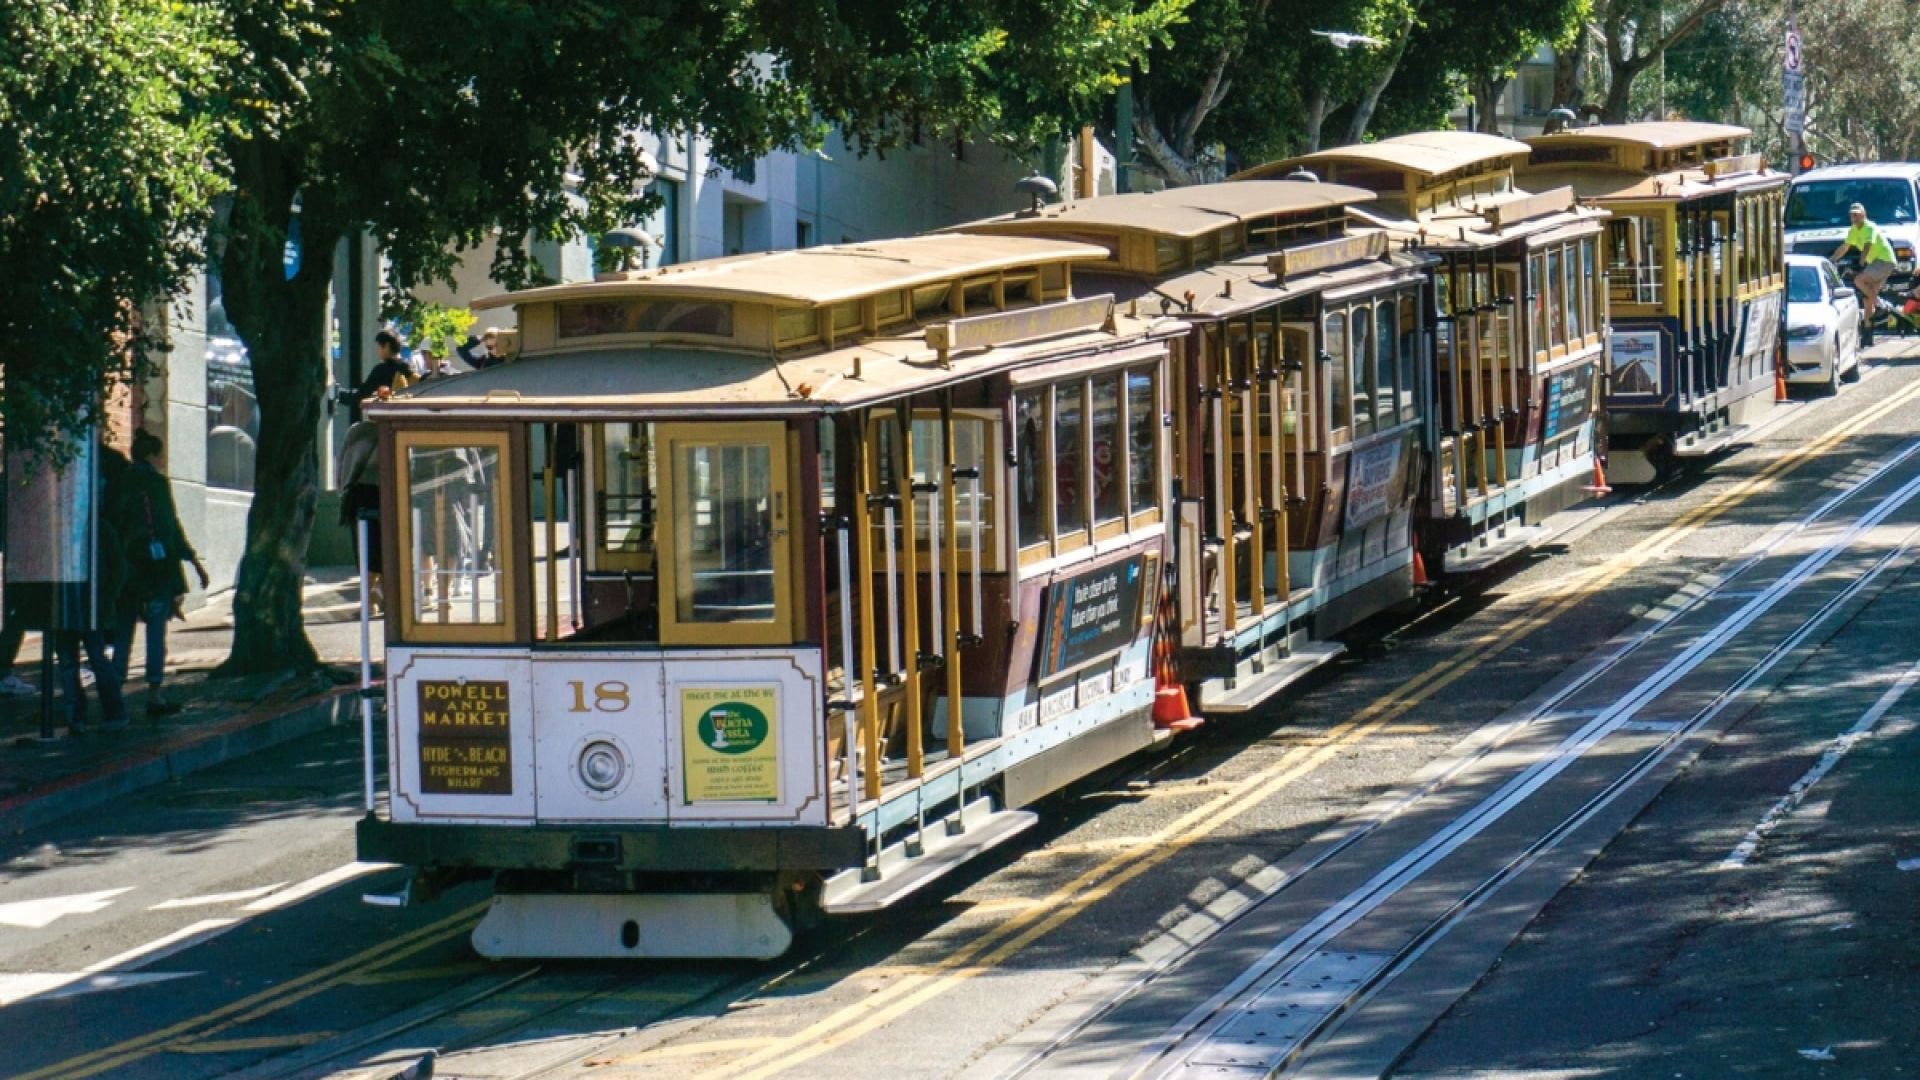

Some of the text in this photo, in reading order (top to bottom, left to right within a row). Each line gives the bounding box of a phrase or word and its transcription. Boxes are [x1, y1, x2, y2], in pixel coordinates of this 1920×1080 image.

[423, 684, 507, 700] POWELL
[567, 680, 630, 713] 18
[446, 701, 488, 711] AND
[423, 711, 509, 726] MARKET
[423, 747, 450, 763] HYDE
[468, 746, 507, 763] BEACH
[430, 765, 501, 777] FISHERMANS
